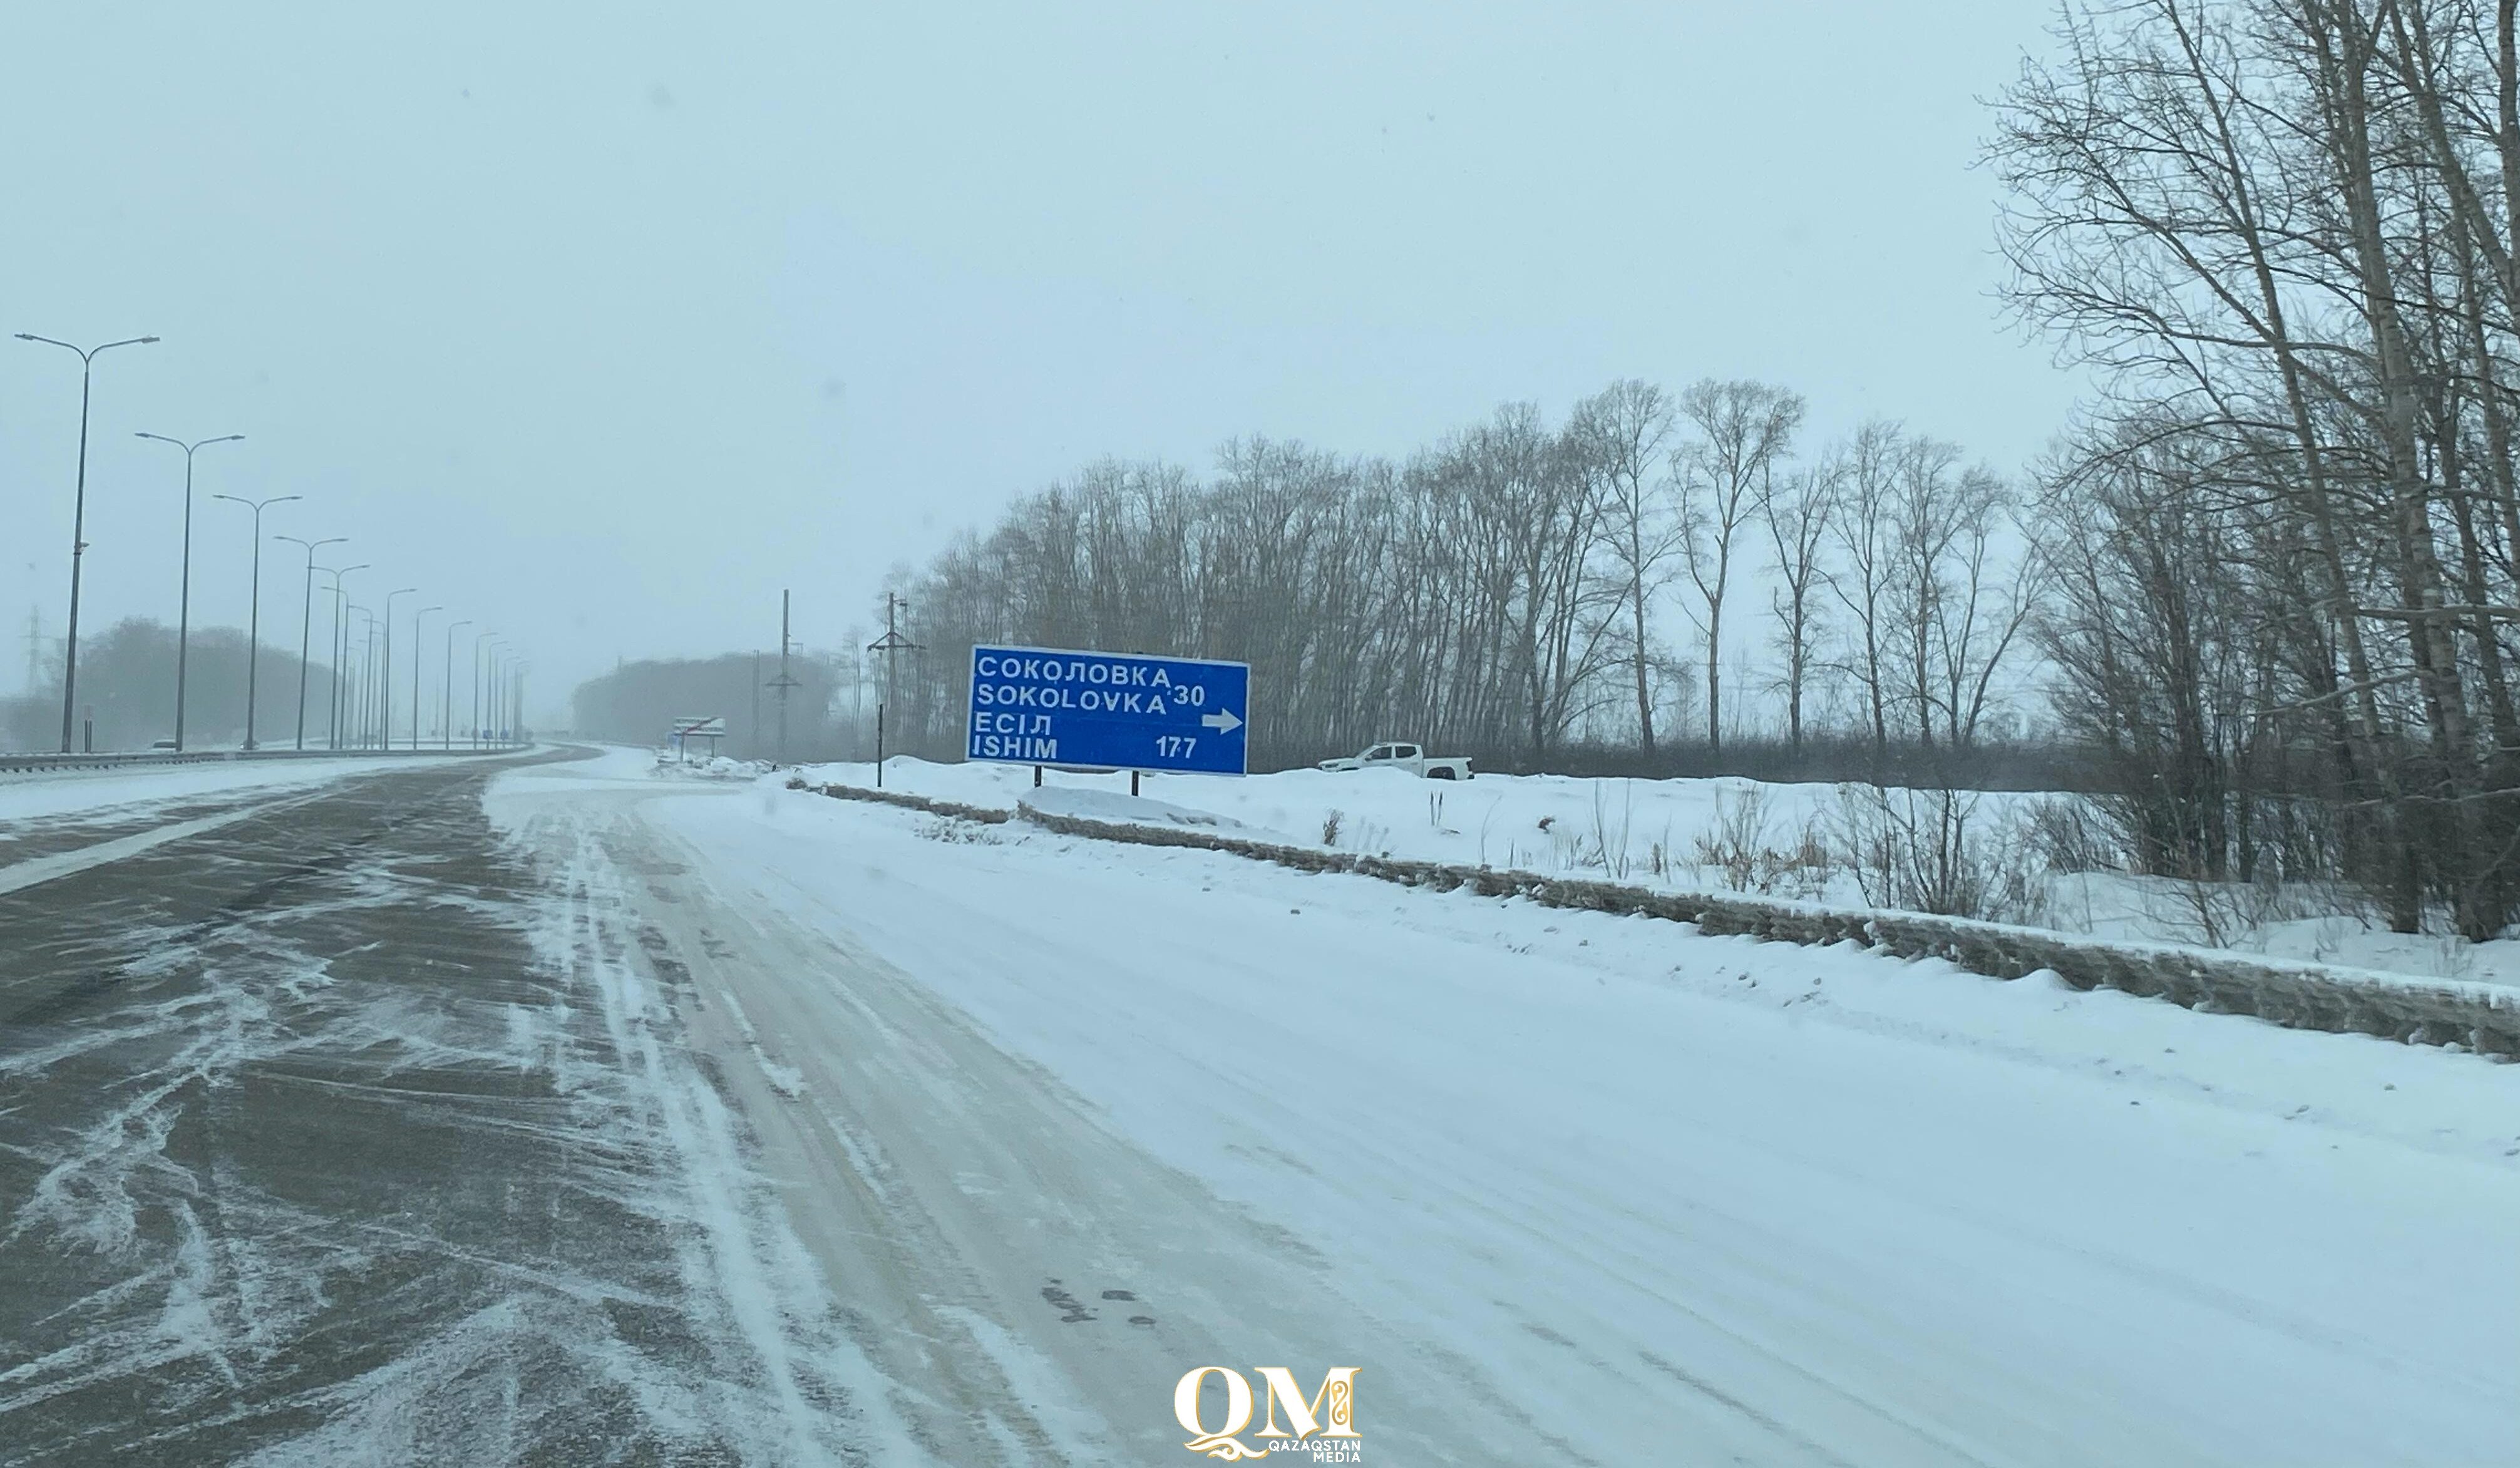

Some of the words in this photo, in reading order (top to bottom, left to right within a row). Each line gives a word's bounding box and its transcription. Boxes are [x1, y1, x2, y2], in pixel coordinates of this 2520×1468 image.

[977, 657, 1171, 687] СОКОЛОВКА
[977, 684, 1167, 715] SOKOLOVKA
[1173, 685, 1205, 707] 30
[975, 712, 1051, 736] ЕСІЛ
[973, 735, 1057, 759] ISHIM
[1156, 736, 1197, 759] 177
